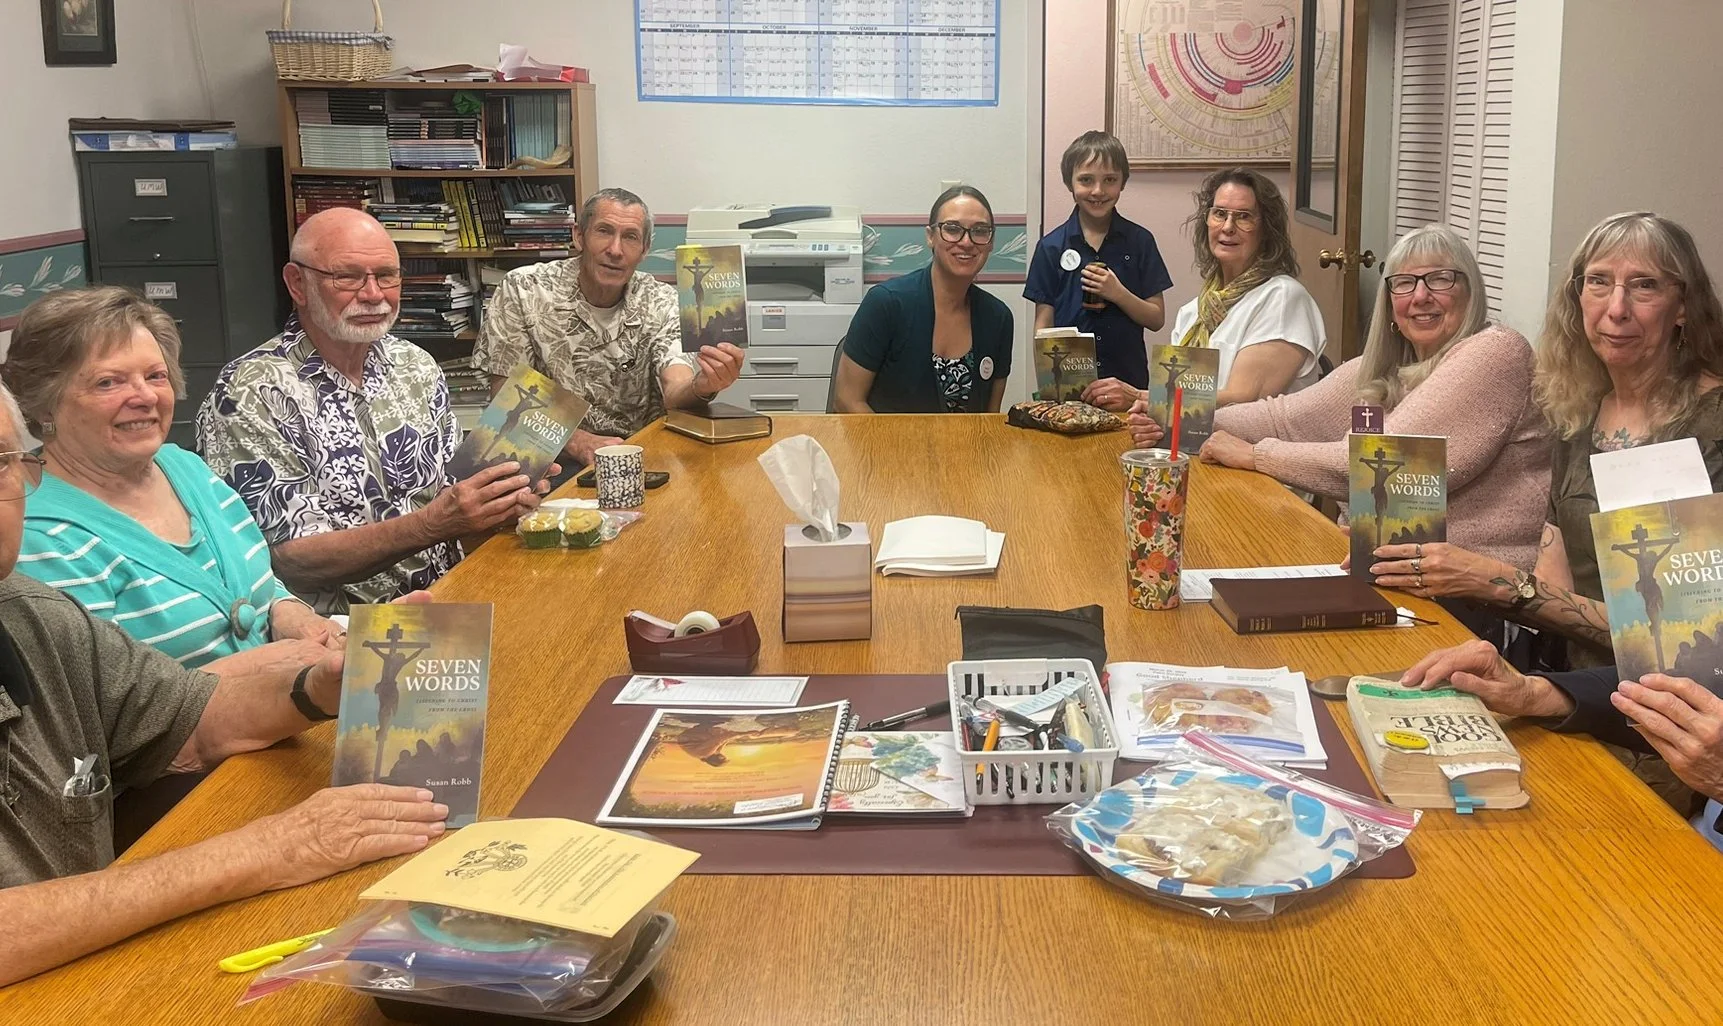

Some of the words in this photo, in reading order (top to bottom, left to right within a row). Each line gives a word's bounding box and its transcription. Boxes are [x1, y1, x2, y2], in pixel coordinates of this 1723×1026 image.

[708, 271, 740, 281] SEVEN
[704, 280, 741, 289] WORDS
[1062, 363, 1095, 371] WORDS
[1066, 357, 1094, 365] SEVEN
[1183, 373, 1215, 384] SEVEN
[1178, 380, 1214, 391] WORDS
[531, 410, 568, 437] SEVEN
[522, 416, 562, 445] WORDS
[1396, 472, 1440, 486] SEVEN
[1390, 483, 1441, 498] WORDS
[415, 659, 482, 675] SEVEN
[404, 675, 480, 692] WORDS
[1390, 714, 1490, 728] BIBLE
[425, 778, 449, 786] Susan
[451, 777, 472, 786] Robb
